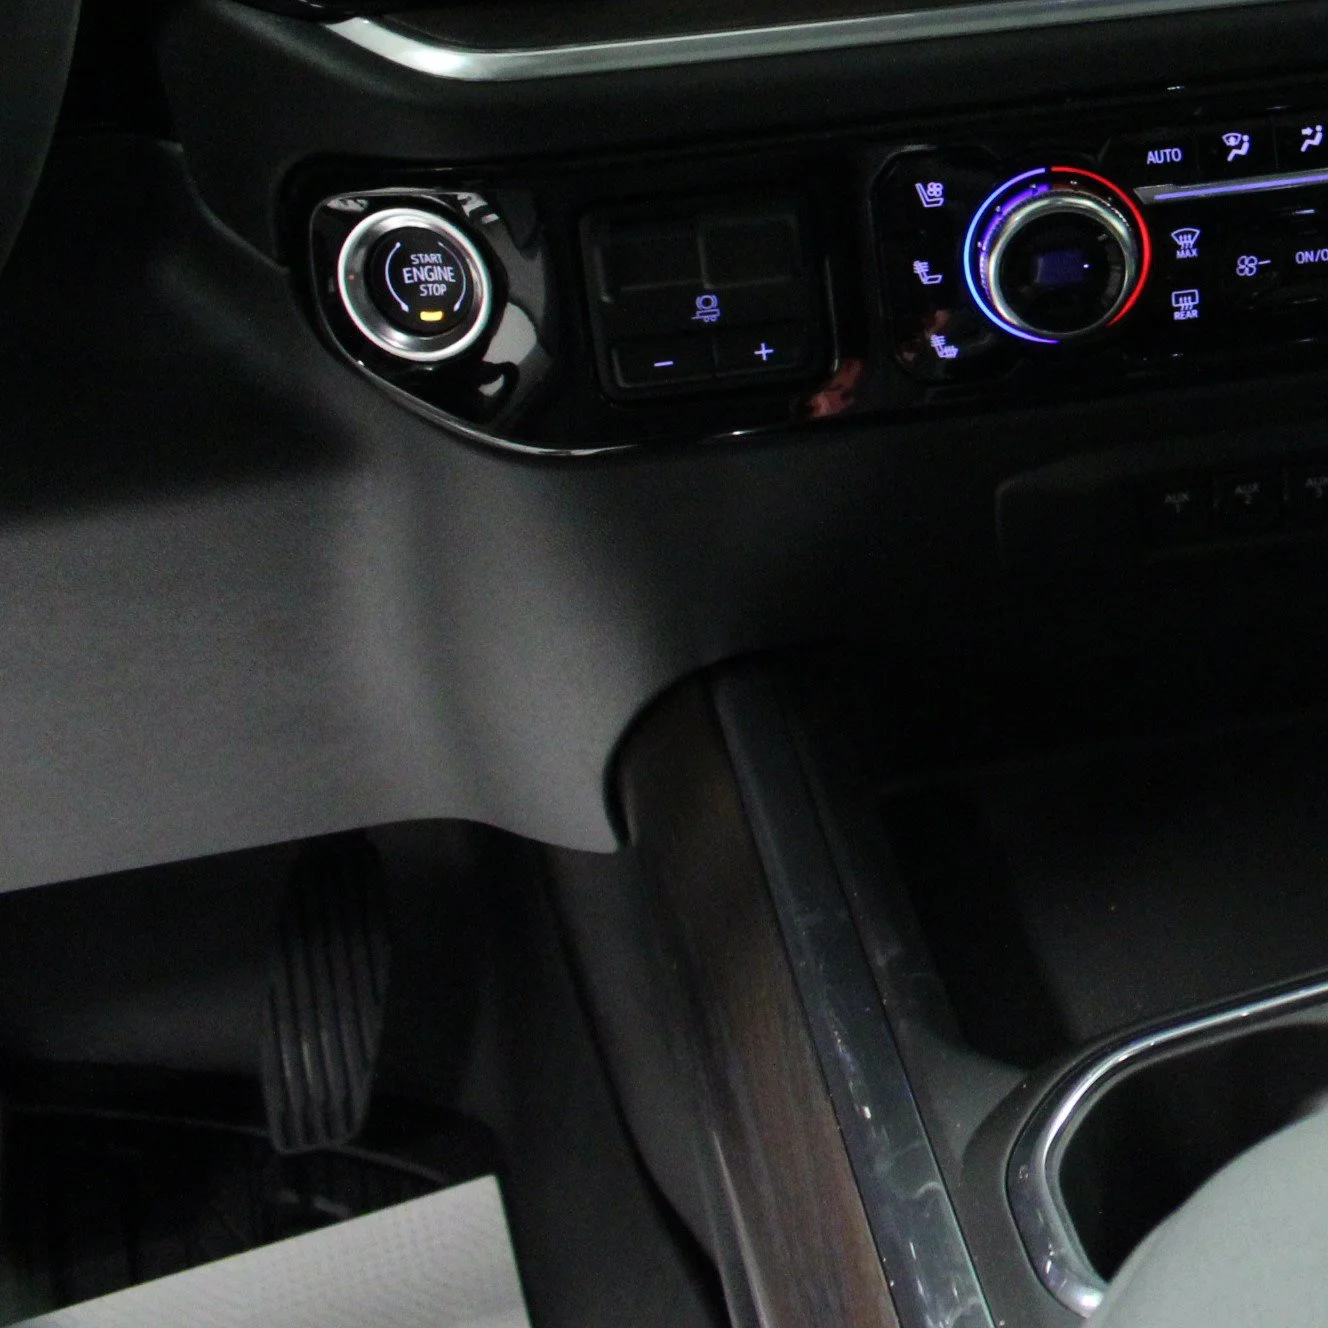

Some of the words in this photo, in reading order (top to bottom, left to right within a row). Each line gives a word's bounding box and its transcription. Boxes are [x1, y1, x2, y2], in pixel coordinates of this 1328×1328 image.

[1146, 147, 1183, 165] AUTO
[410, 253, 443, 265] START
[1176, 248, 1199, 259] MAX
[402, 265, 456, 284] ENGINE
[419, 283, 447, 297] STOP
[1173, 309, 1199, 321] REAR
